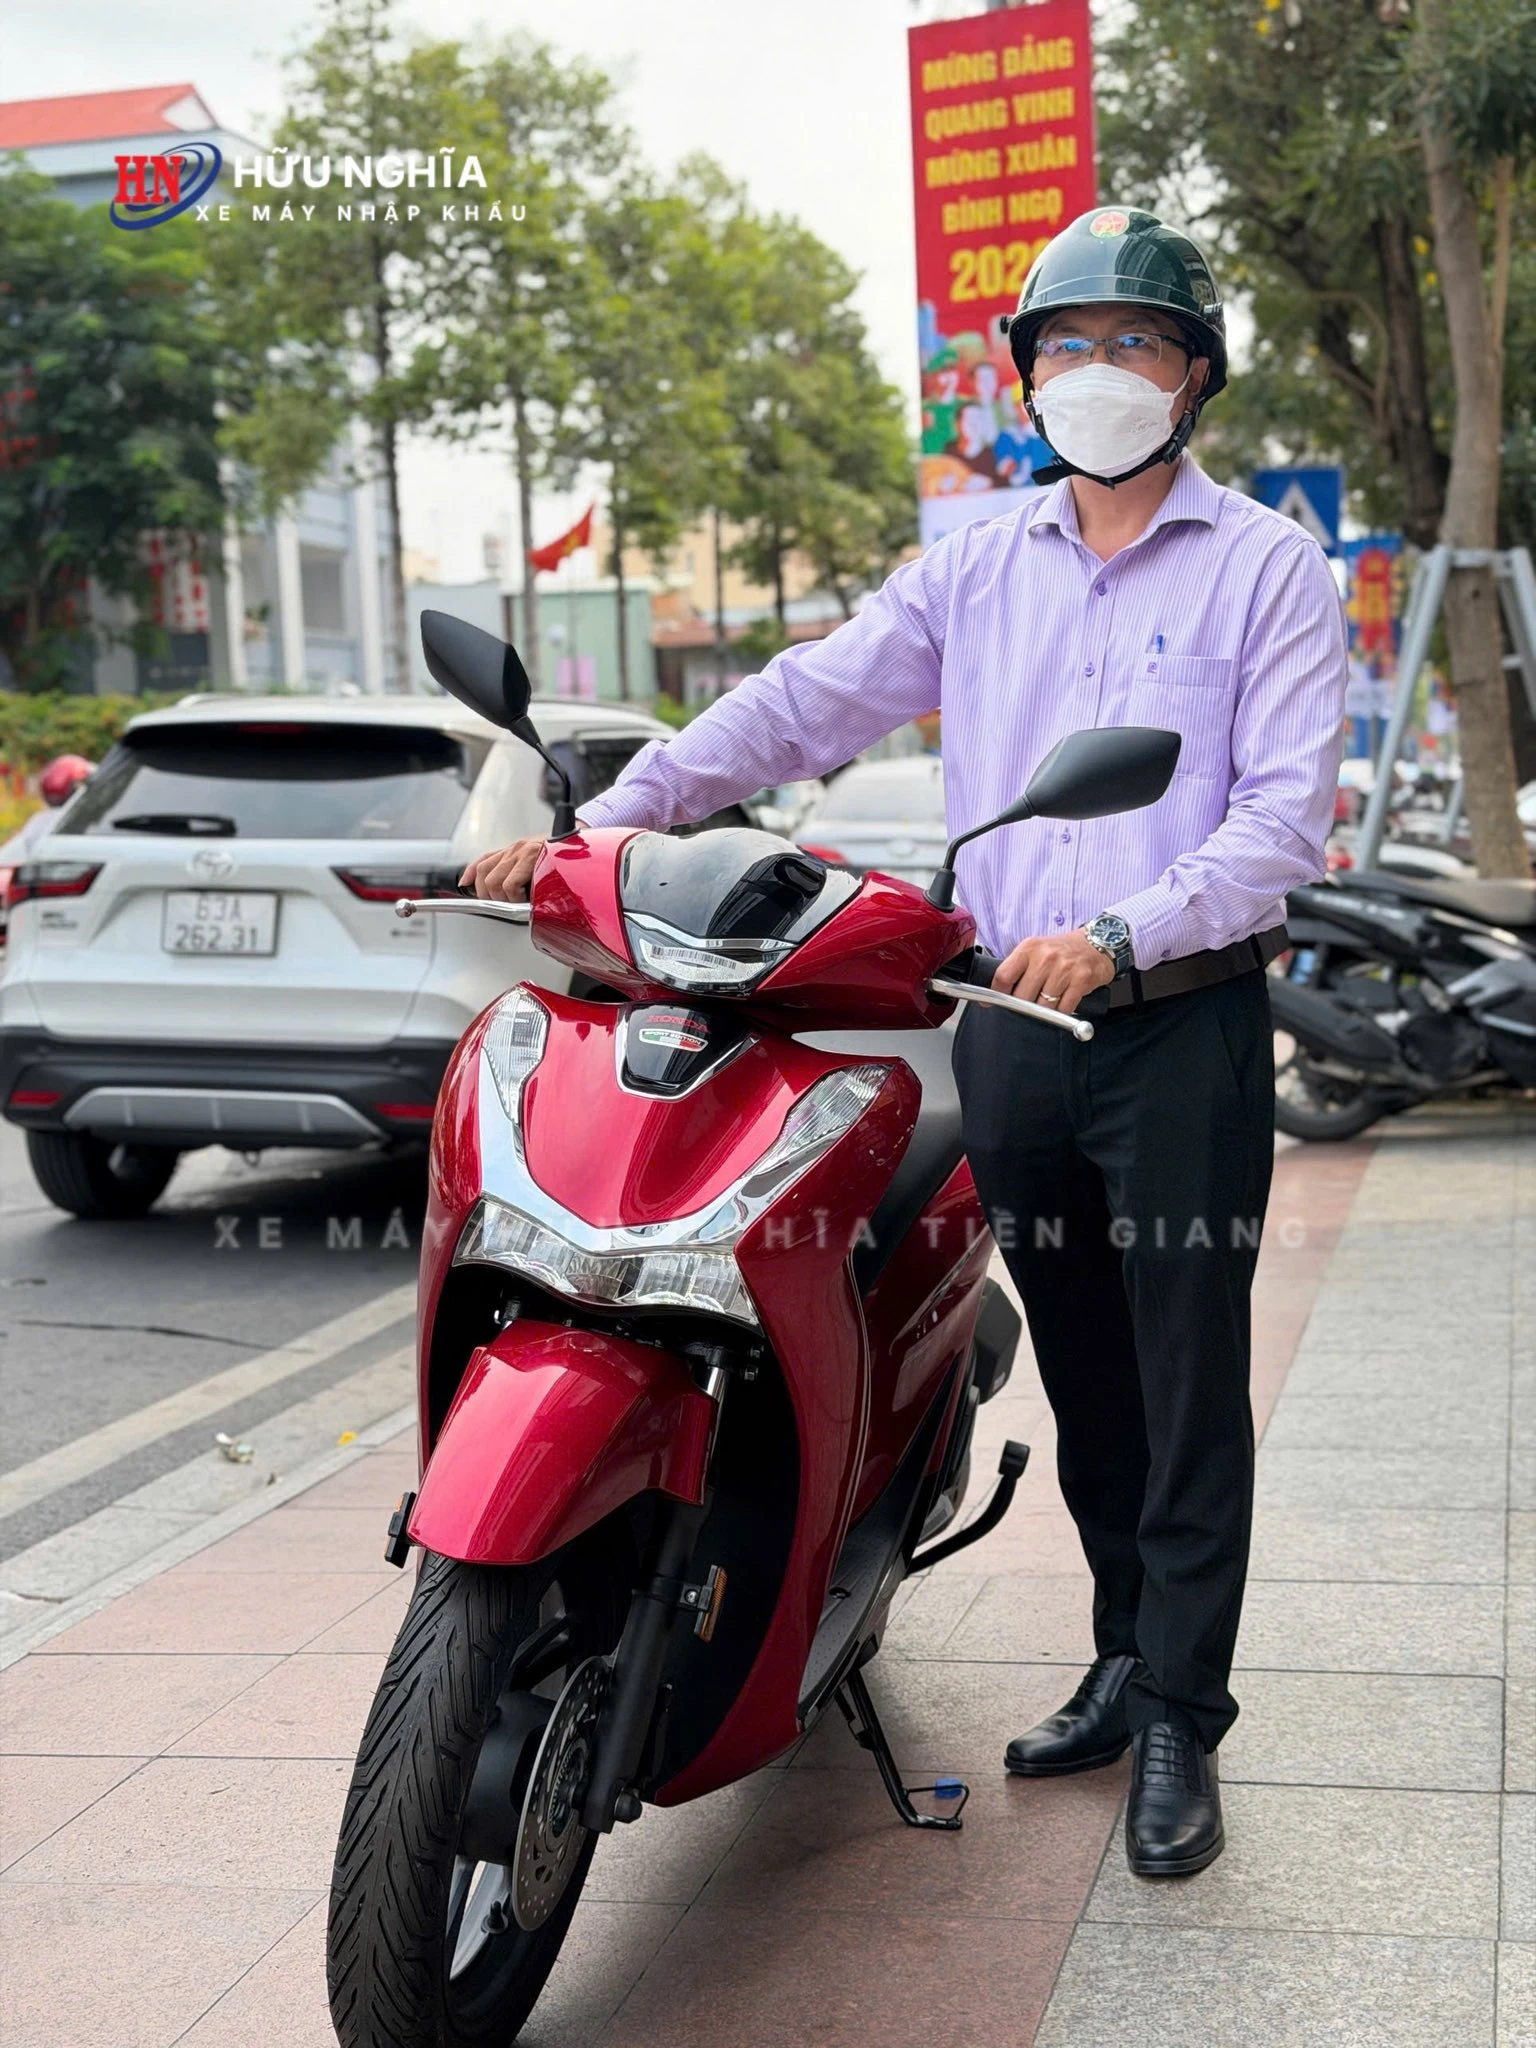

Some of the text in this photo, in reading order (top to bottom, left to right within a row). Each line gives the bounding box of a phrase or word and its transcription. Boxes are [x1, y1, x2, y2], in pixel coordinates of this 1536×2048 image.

[922, 52, 997, 92] MỪNG
[924, 86, 1075, 142] QUANG VINH
[926, 133, 1078, 188] MỪNG XUÂN
[942, 187, 1063, 234] BÌNH NGỌ
[950, 238, 1052, 303] 202
